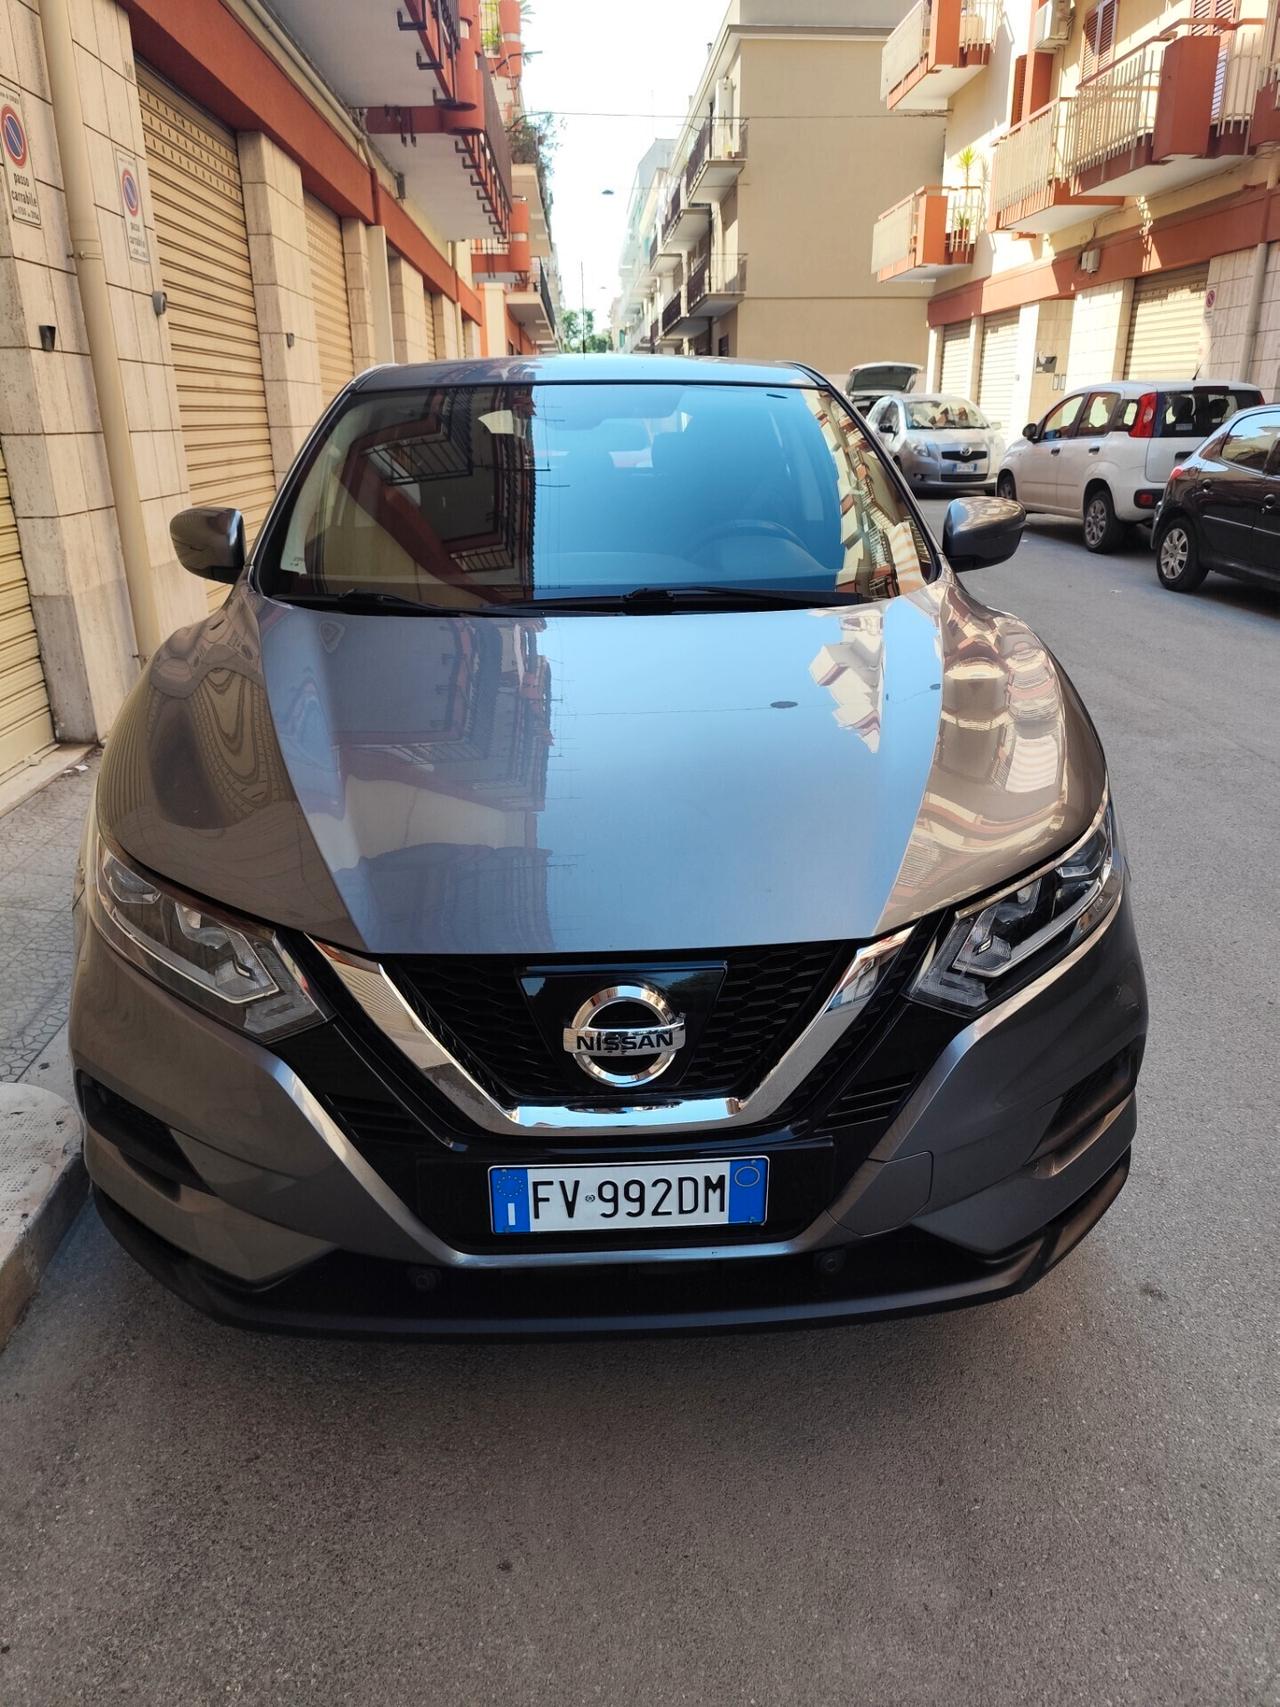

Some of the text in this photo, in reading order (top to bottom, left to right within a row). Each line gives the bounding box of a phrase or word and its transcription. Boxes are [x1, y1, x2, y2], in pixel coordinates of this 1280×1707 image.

[576, 1031, 673, 1052] NISSAN
[531, 1174, 726, 1220] FV 992DM
